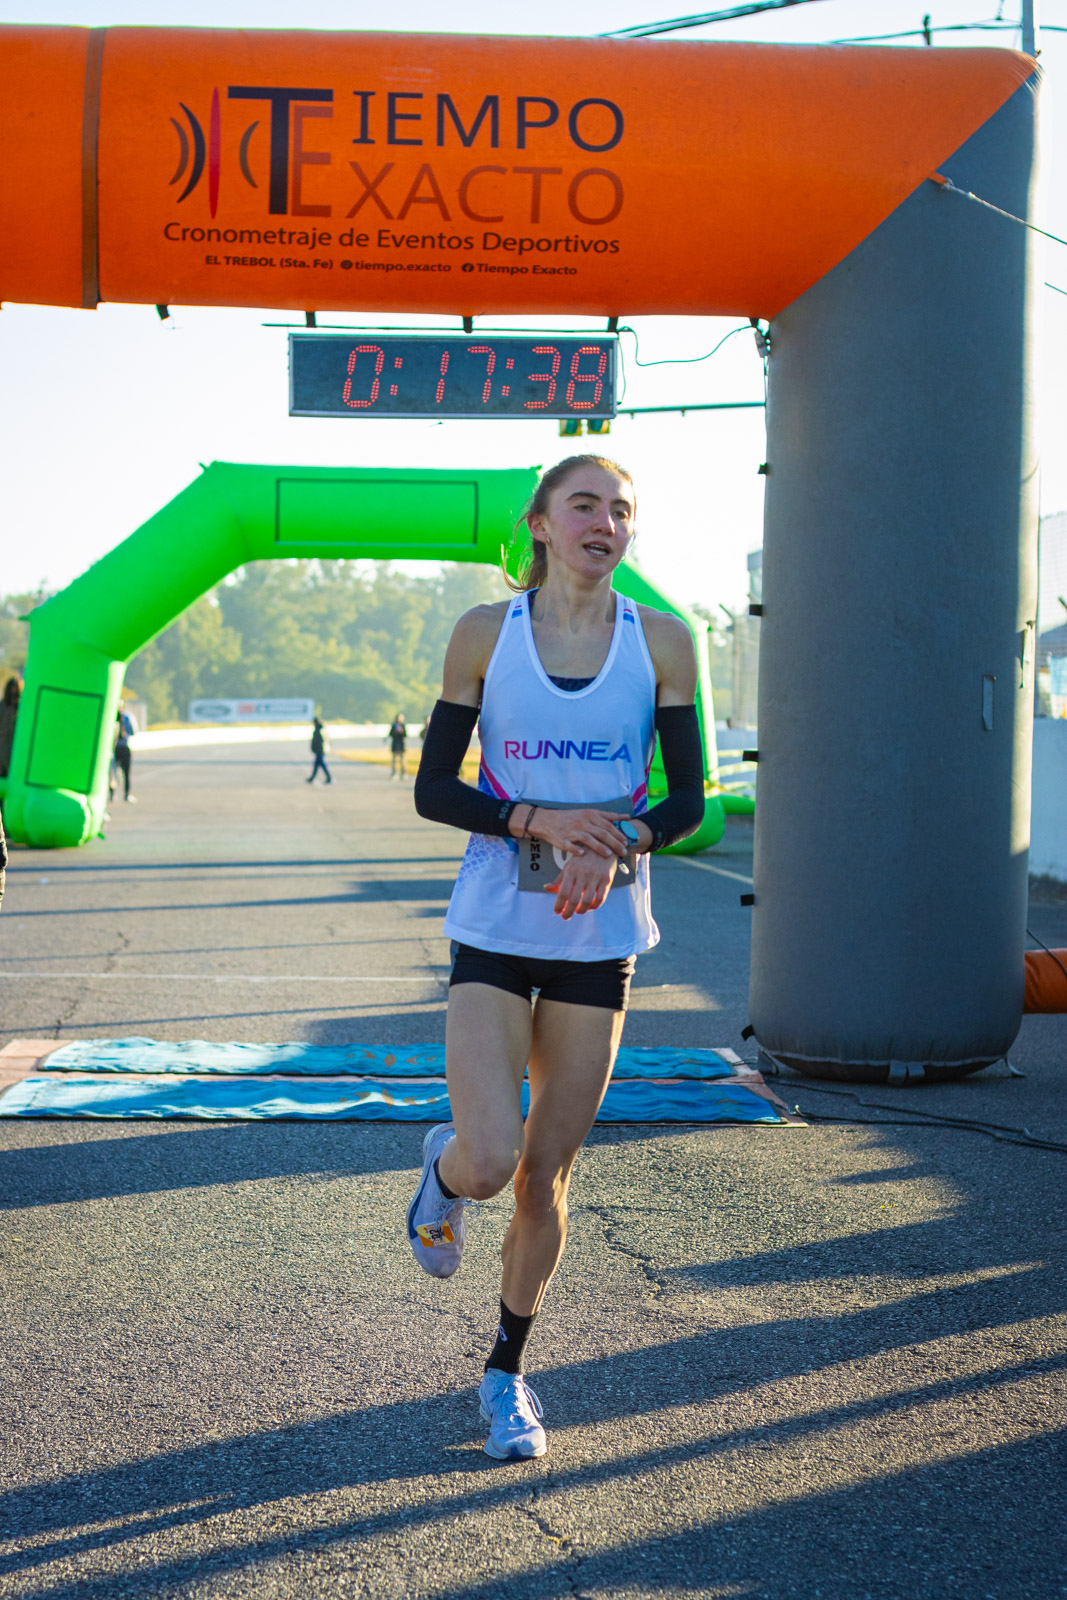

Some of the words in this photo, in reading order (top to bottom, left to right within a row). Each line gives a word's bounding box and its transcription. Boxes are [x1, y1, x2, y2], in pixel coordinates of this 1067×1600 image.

[227, 85, 625, 214] TIEMPO
[291, 104, 625, 225] EXACTO
[163, 222, 332, 250] Cronometraje
[338, 228, 370, 247] de
[377, 229, 475, 249] Eventos
[482, 232, 620, 255] Deportivos
[205, 255, 221, 265] EL
[224, 255, 276, 267] TREBOL
[279, 257, 311, 269] (Sta.
[313, 258, 334, 270] Fe)
[355, 260, 452, 273] tiempo.exacto
[476, 263, 529, 275] Tiempo
[532, 264, 578, 275] Exacto
[343, 345, 607, 408] 0:17:38
[504, 739, 632, 763] RUNNEA
